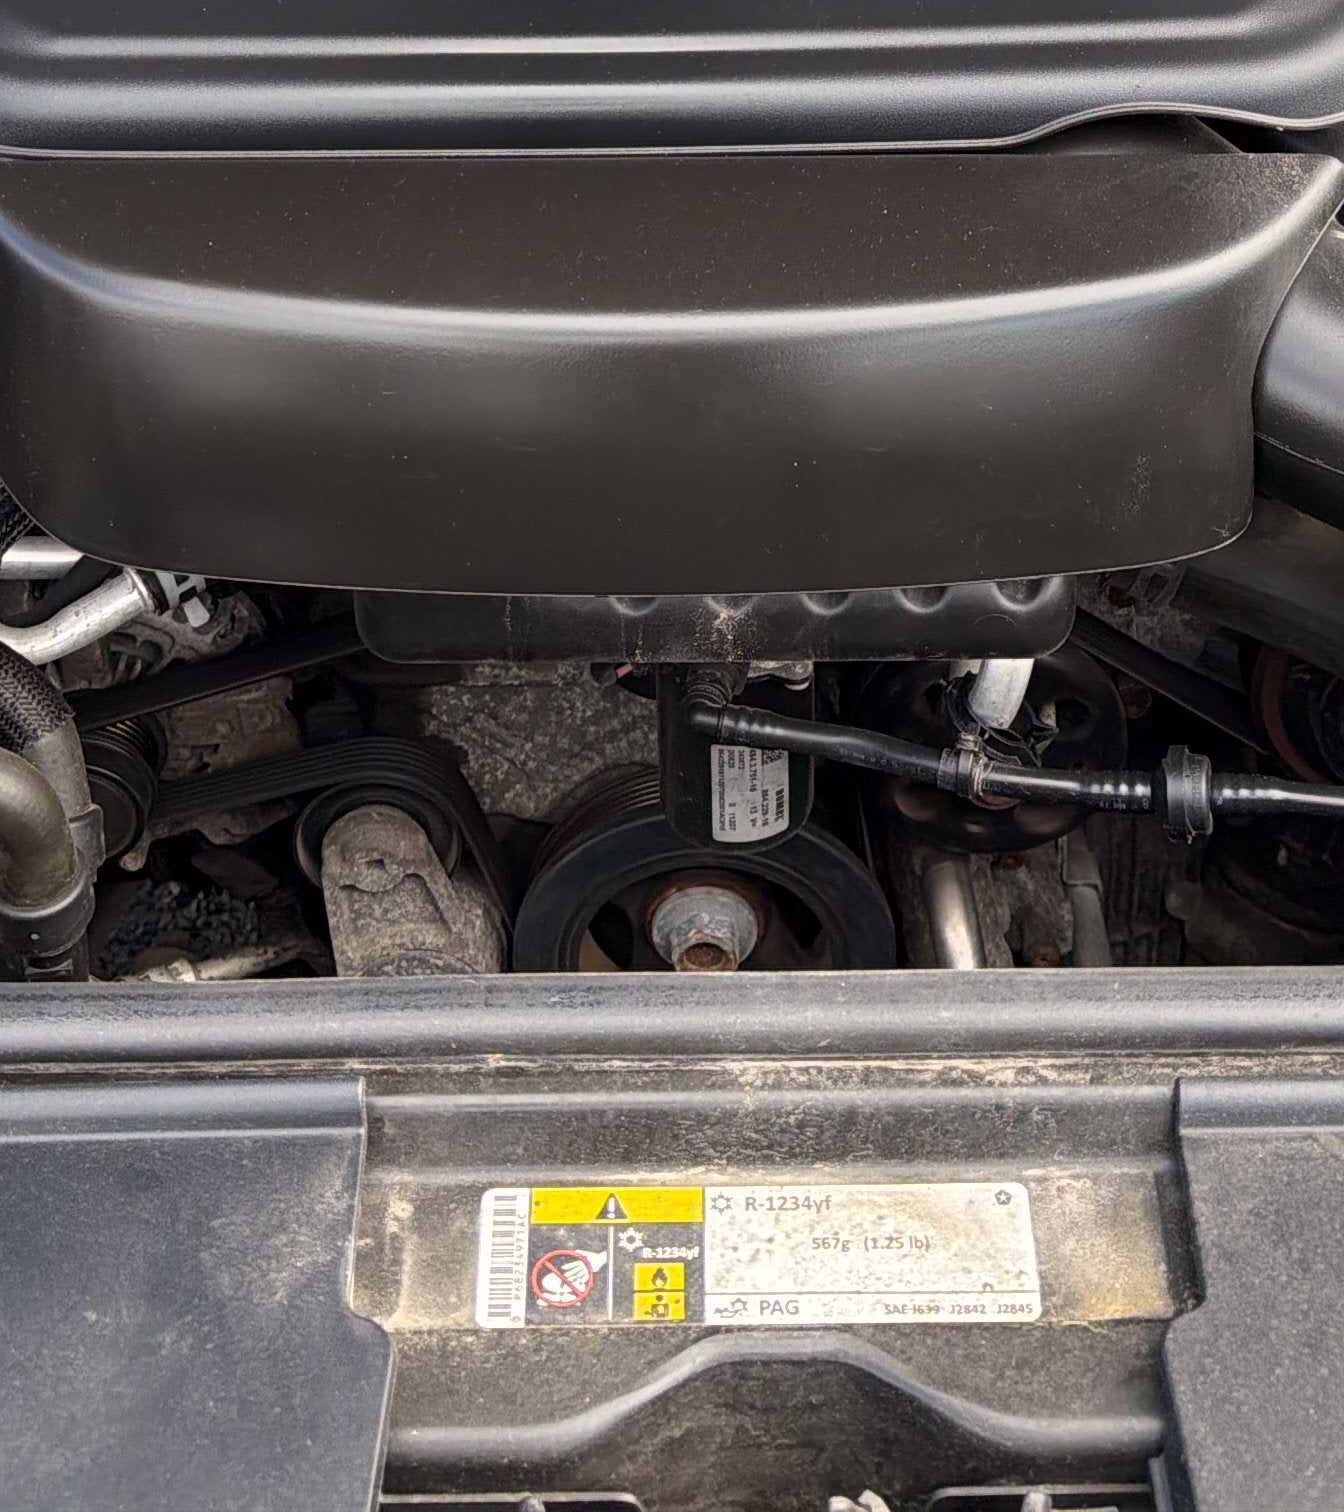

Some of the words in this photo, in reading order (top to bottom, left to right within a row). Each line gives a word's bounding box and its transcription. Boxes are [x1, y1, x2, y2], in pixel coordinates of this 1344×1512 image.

[744, 1193, 832, 1214] R-1234yf
[811, 1237, 851, 1253] 567g
[863, 1235, 904, 1252] (1.25
[909, 1235, 931, 1252] lb)
[642, 1246, 700, 1261] R-1234yf
[759, 1300, 800, 1316] PAG
[996, 1303, 1033, 1315] J2845
